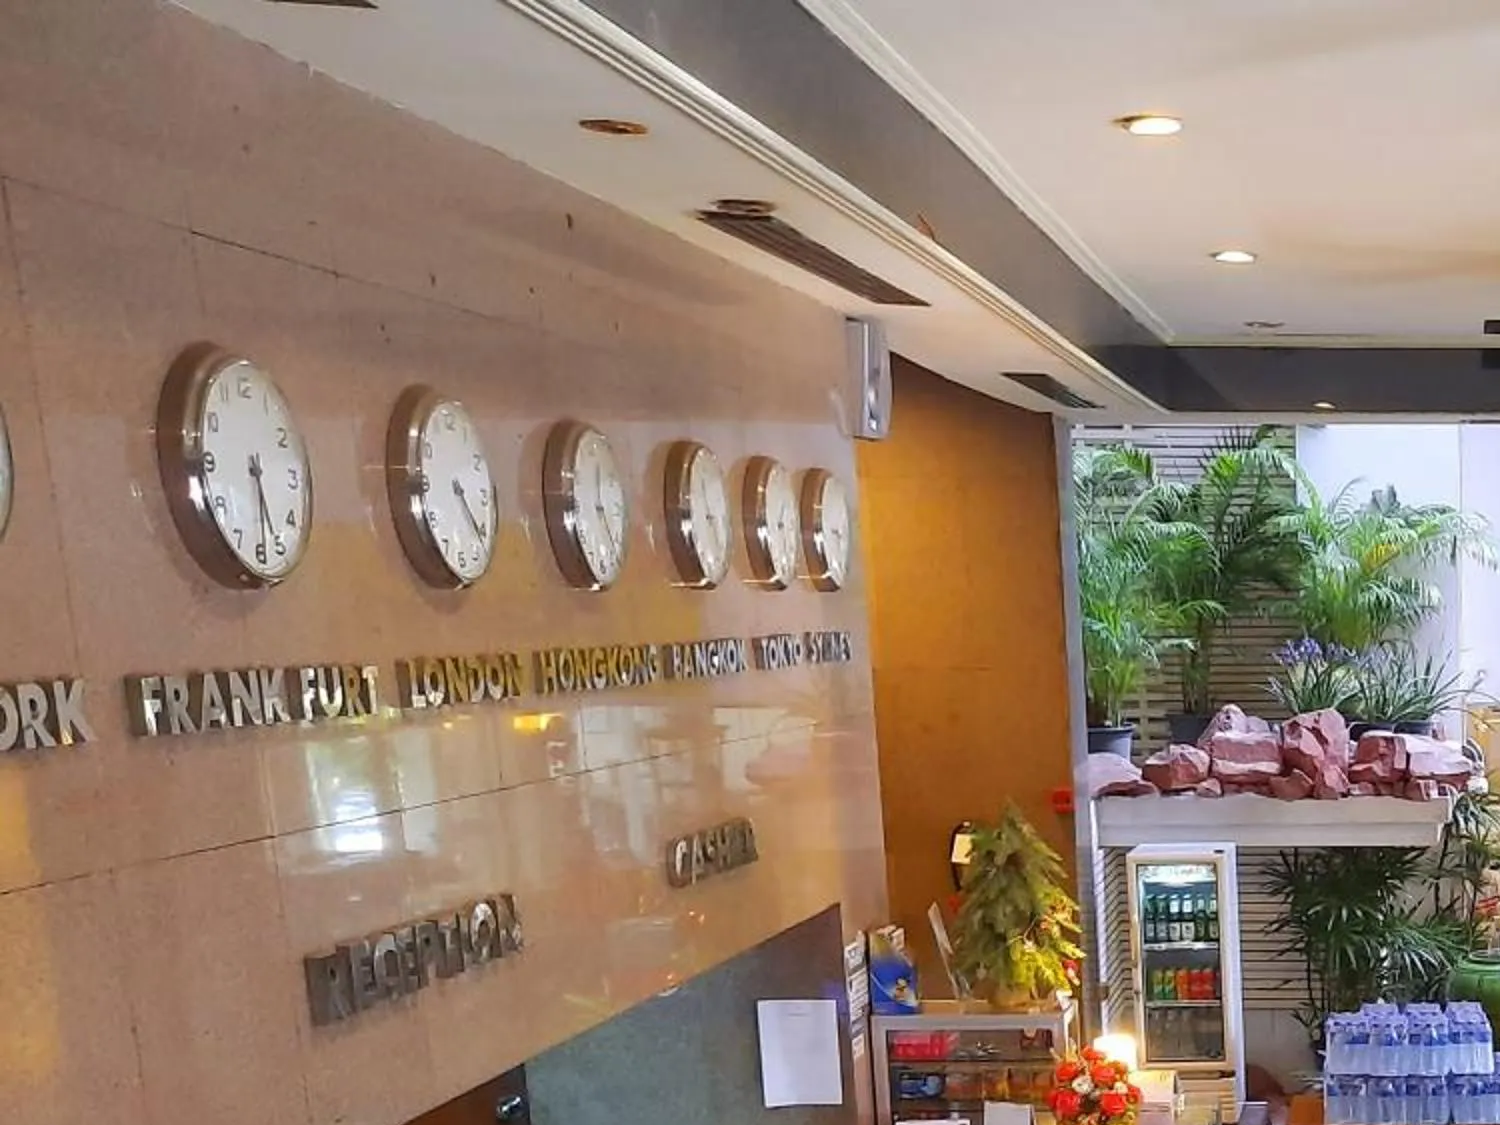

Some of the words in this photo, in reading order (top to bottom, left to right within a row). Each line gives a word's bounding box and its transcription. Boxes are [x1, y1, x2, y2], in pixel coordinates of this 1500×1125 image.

[277, 428, 288, 449] 2
[204, 452, 216, 472] 9
[288, 469, 299, 490] 3
[286, 510, 297, 527] 4
[233, 529, 243, 549] 7
[275, 535, 287, 556] 5
[671, 638, 748, 680] BANGKOK
[757, 634, 803, 671] TOKYO
[403, 652, 521, 707] LONDON
[536, 645, 659, 695] HONGKONG
